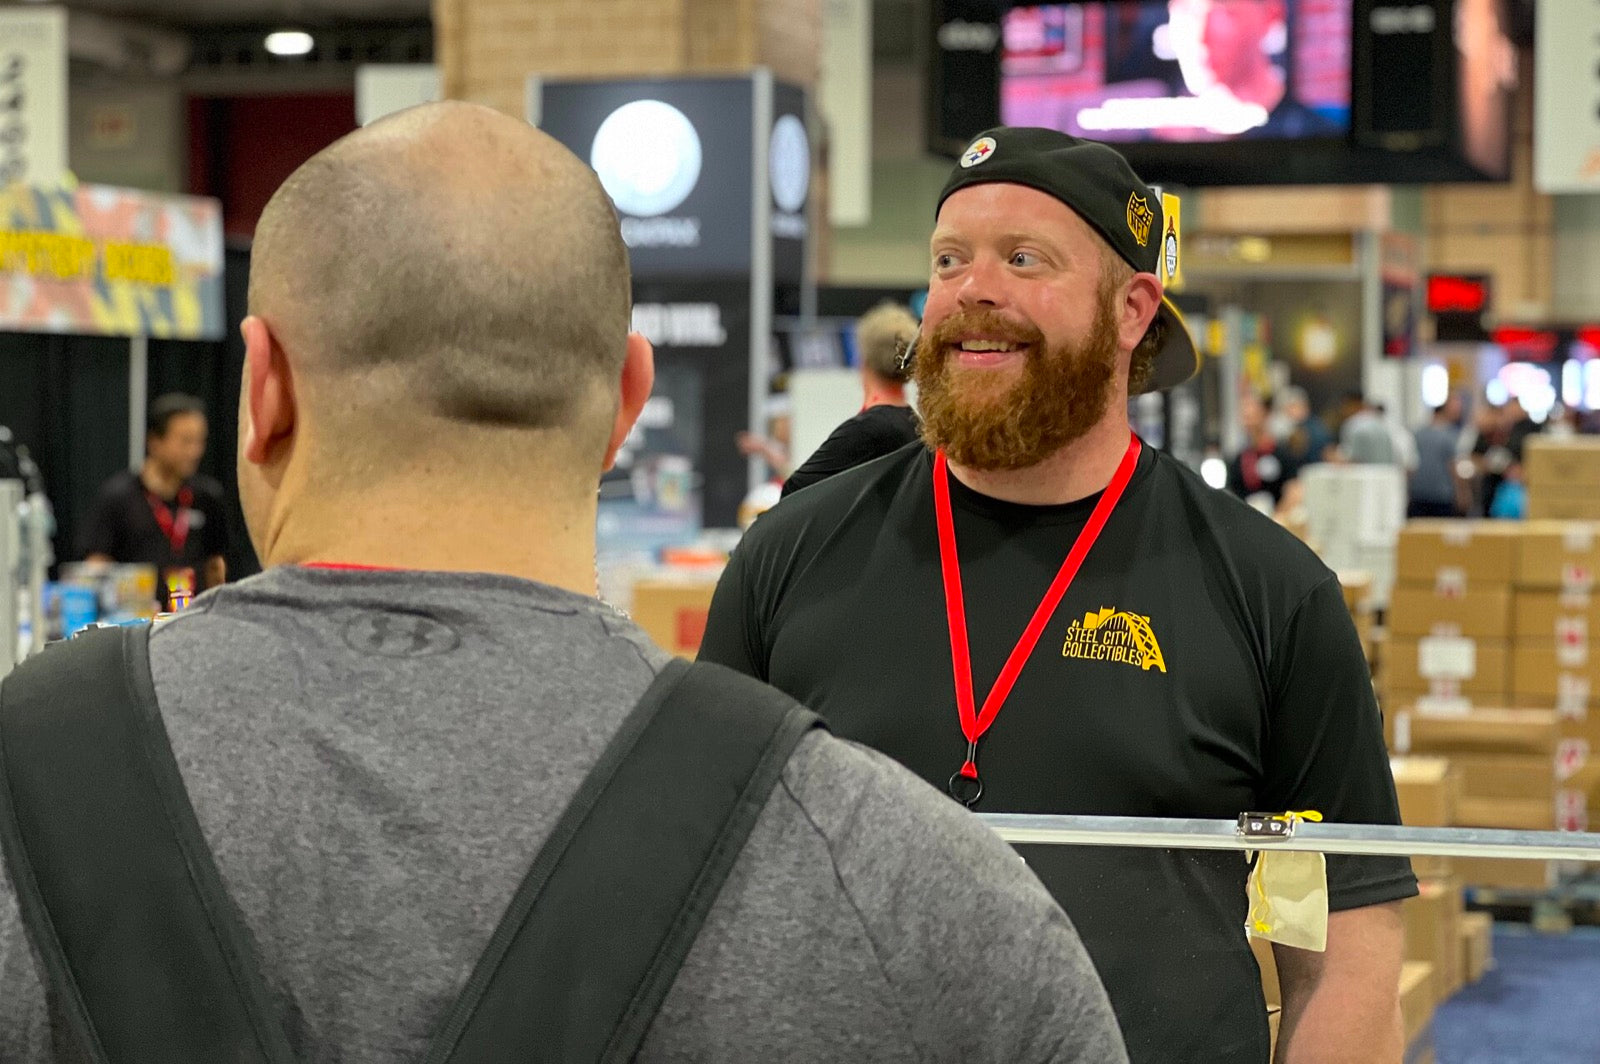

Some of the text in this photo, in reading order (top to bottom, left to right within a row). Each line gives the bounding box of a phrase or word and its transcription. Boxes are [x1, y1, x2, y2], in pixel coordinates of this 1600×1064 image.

[1129, 210, 1148, 241] NFL
[1066, 627, 1127, 646] STEEL CITY
[1062, 642, 1143, 666] COLLECTIBLES
